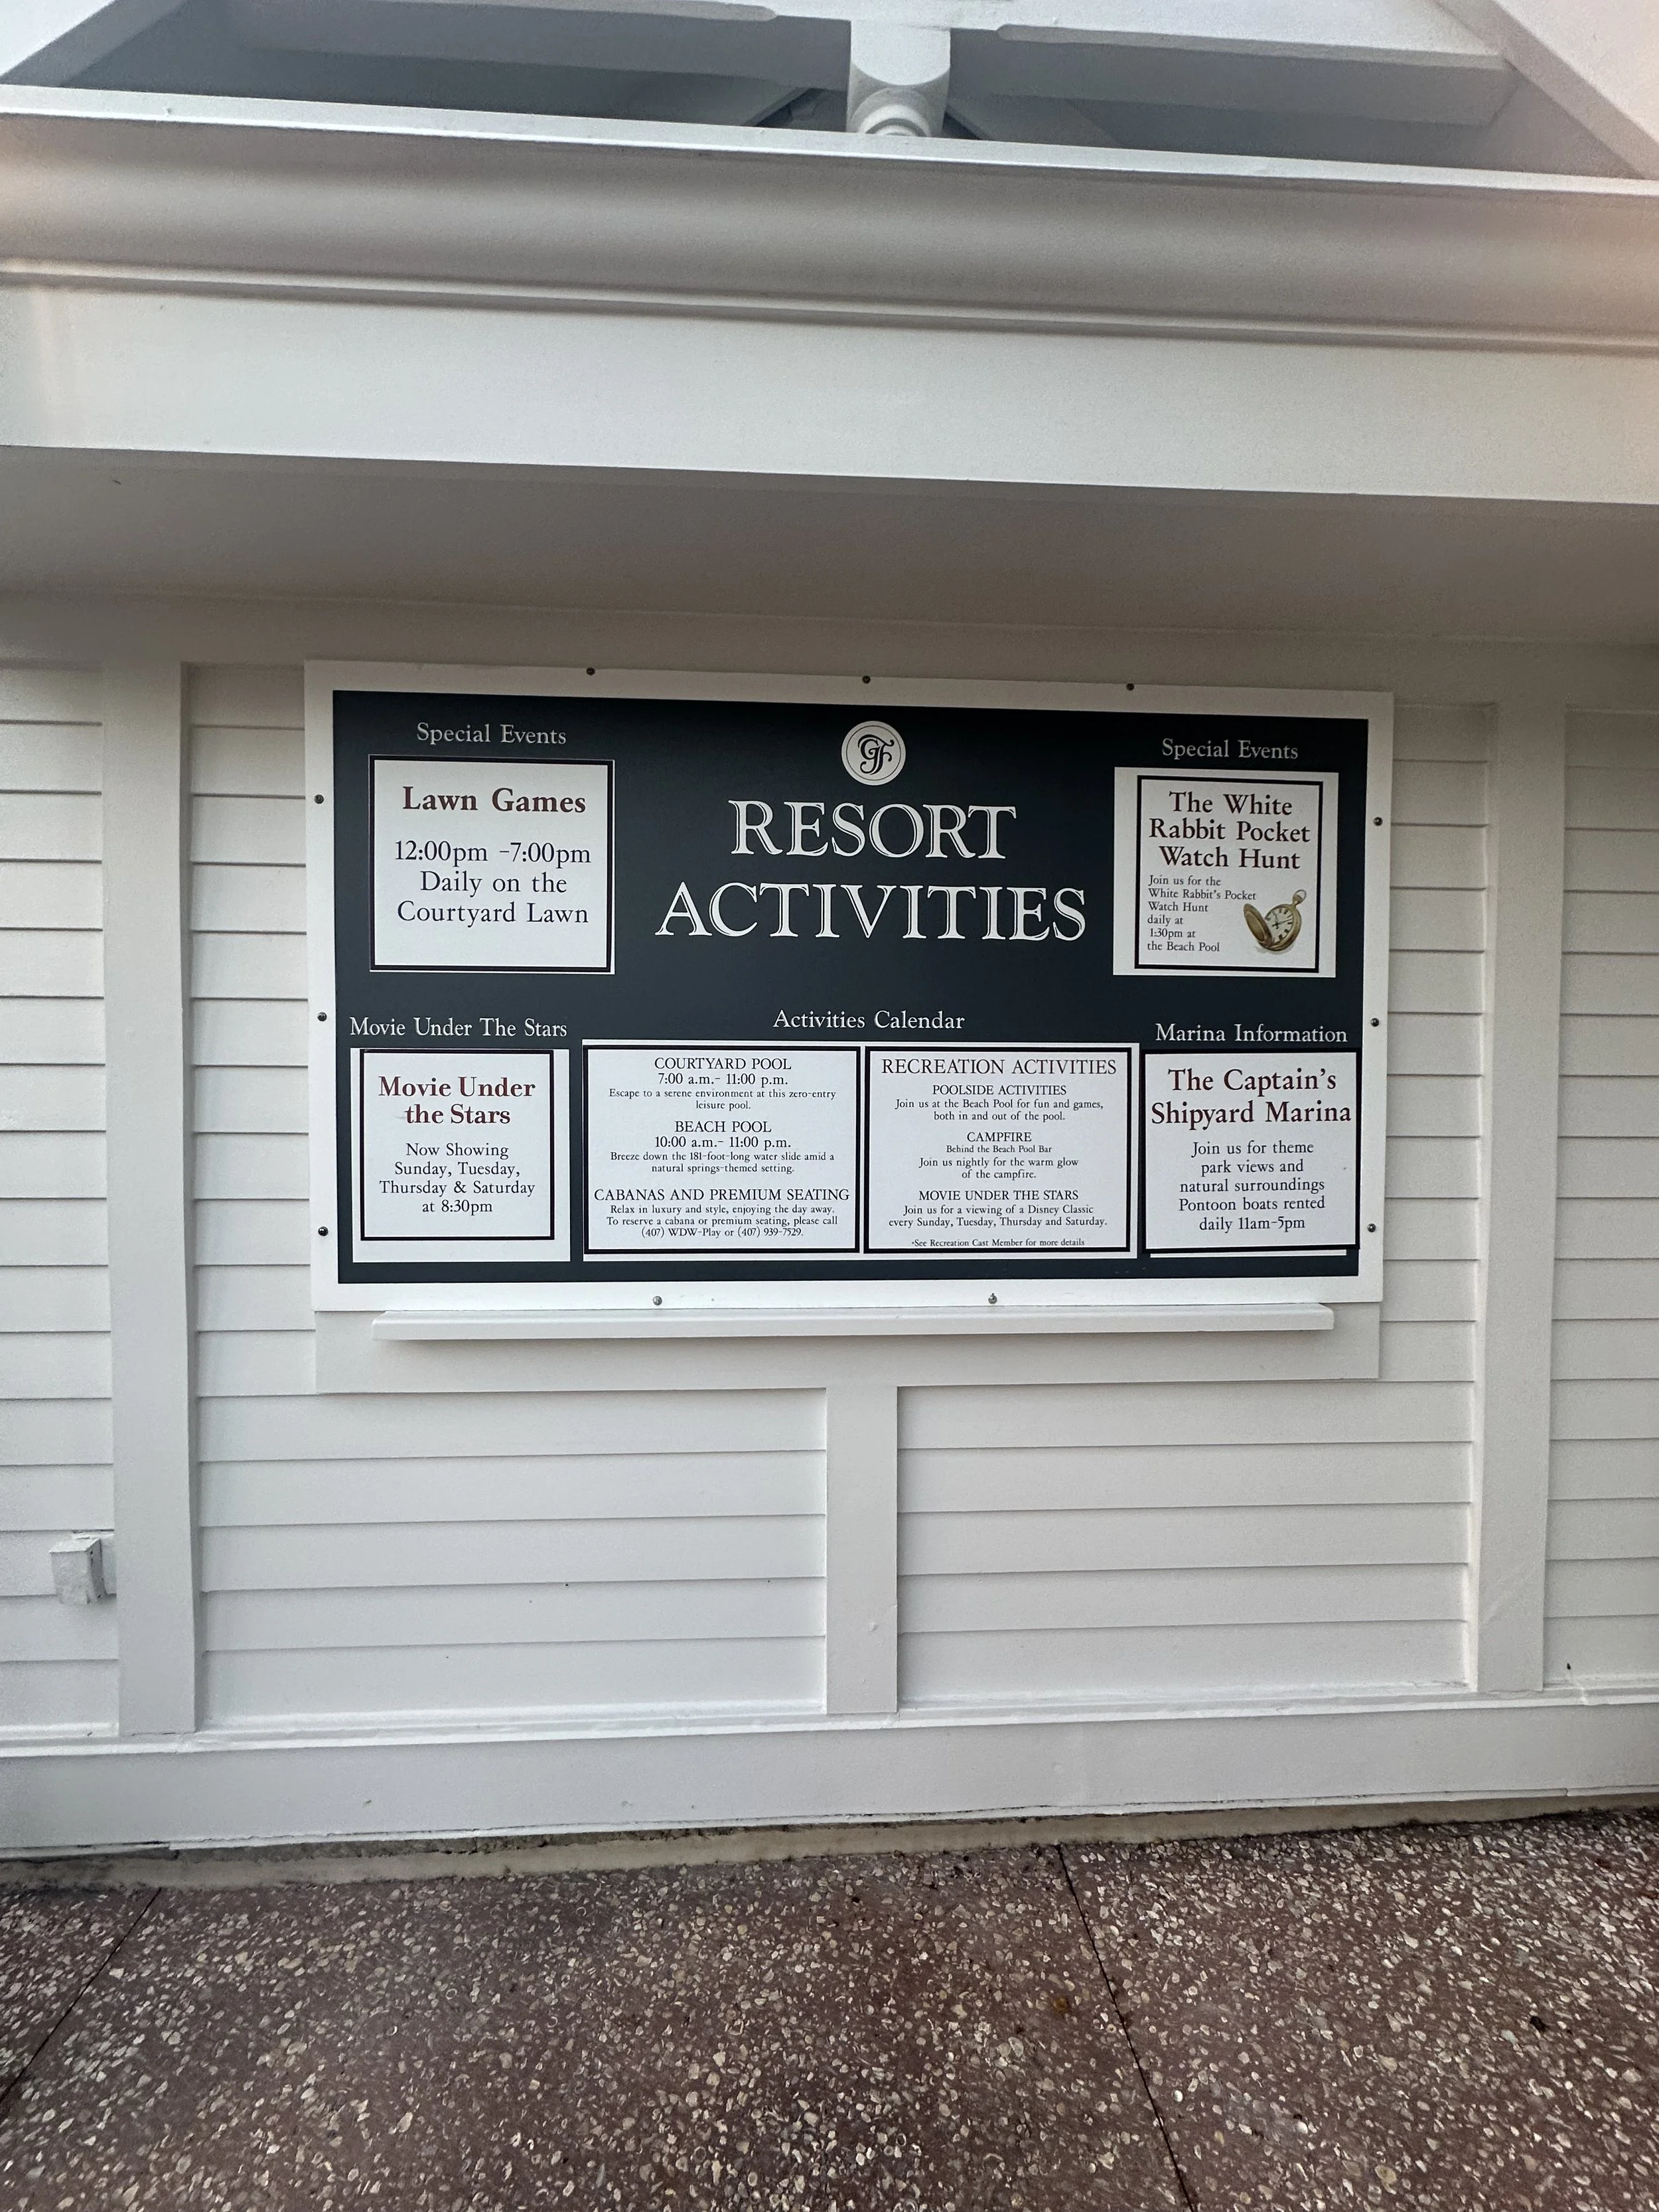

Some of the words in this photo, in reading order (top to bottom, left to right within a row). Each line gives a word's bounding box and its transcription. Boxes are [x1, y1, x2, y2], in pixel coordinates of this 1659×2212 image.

[417, 721, 491, 745] Special
[500, 724, 566, 745] Events
[1162, 738, 1230, 760] Special
[1238, 739, 1298, 759] Events
[402, 786, 478, 811] Lawn
[492, 787, 586, 813] Games
[1169, 790, 1213, 813] The
[1222, 793, 1293, 816] White
[728, 800, 1017, 859] RESORT
[1149, 817, 1226, 840] Rabbit
[1236, 820, 1311, 843] Pocket
[395, 840, 488, 867] 12:00pm
[1158, 846, 1230, 867] Watch
[1238, 848, 1301, 870] Hunt
[420, 870, 482, 897] Daily
[492, 878, 521, 892] on
[532, 871, 567, 893] the
[1147, 874, 1169, 887] Join
[1187, 875, 1202, 886] for
[1205, 875, 1222, 886] the
[1148, 887, 1179, 898] White
[1183, 889, 1221, 899] Rabbit's
[1224, 890, 1256, 901] Pocket
[397, 900, 516, 928] Courtyard
[526, 902, 589, 923] Lawn
[654, 881, 1086, 941] ACTIVITIES
[1147, 901, 1179, 911] Watch
[1183, 902, 1208, 913] Hunt
[1147, 914, 1171, 927] daily
[1150, 927, 1183, 940] 1:30pm
[1147, 940, 1163, 951] the
[1167, 940, 1195, 951] Beach
[1198, 942, 1220, 952] Pool
[349, 1017, 405, 1036] Movie
[413, 1017, 472, 1037] Under
[479, 1017, 516, 1037] The
[524, 1017, 567, 1037] Stars
[772, 1009, 865, 1028] Activities
[874, 1010, 966, 1029] Calendar
[1155, 1023, 1226, 1041] Marina
[1234, 1023, 1348, 1043] Information
[654, 1057, 747, 1070] COURTYARD
[751, 1057, 792, 1070] POOL
[881, 1059, 1005, 1074] RECREATION
[1011, 1059, 1117, 1074] ACTIVITIES
[378, 1076, 451, 1097] Movie
[457, 1076, 536, 1097] Under
[658, 1072, 684, 1084] 7:00
[726, 1072, 756, 1085] 11:00
[760, 1076, 788, 1088] p.m.
[1167, 1068, 1214, 1091] The
[1224, 1067, 1336, 1097] Captain's
[609, 1088, 640, 1100] Escape
[768, 1088, 786, 1098] this
[932, 1084, 994, 1095] POOLSIDE
[997, 1084, 1067, 1096] ACTIVITIES
[404, 1104, 444, 1124] the
[451, 1103, 511, 1124] Stars
[696, 1100, 725, 1109] leisure
[729, 1100, 751, 1112] pool.
[1151, 1100, 1255, 1131] Shipyard
[1265, 1100, 1352, 1122] Marina
[675, 1120, 726, 1133] BEACH
[732, 1120, 772, 1133] POOL
[655, 1136, 686, 1147] 10:00
[729, 1136, 758, 1147] 11:00
[764, 1140, 791, 1151] p.m.
[967, 1132, 1032, 1142] CAMPFIRE
[405, 1142, 440, 1156] Now
[446, 1142, 509, 1160] Showing
[610, 1151, 640, 1161] Breeze
[642, 1151, 668, 1161] down
[672, 1151, 686, 1161] the
[781, 1151, 801, 1161] slide
[804, 1151, 826, 1161] amid
[1190, 1141, 1220, 1158] Join
[1226, 1145, 1242, 1155] us
[1247, 1140, 1267, 1154] for
[1272, 1140, 1314, 1154] theme
[395, 1161, 452, 1179] Sunday,
[457, 1161, 520, 1179] Tuesday,
[918, 1157, 938, 1169] Join
[956, 1157, 989, 1169] nightly
[993, 1157, 1007, 1166] for
[1010, 1157, 1025, 1167] the
[1056, 1157, 1078, 1169] glow
[1200, 1159, 1232, 1177] park
[1236, 1159, 1275, 1173] views
[1279, 1158, 1304, 1173] and
[962, 1169, 973, 1179] of
[975, 1169, 991, 1179] the
[993, 1169, 1037, 1181] campfire.
[379, 1180, 447, 1198] Thursday
[453, 1181, 467, 1194] &
[473, 1179, 536, 1197] Saturday
[1180, 1178, 1228, 1193] natural
[1234, 1177, 1325, 1194] surroundings
[594, 1189, 665, 1201] CABANAS
[670, 1189, 704, 1201] AND
[709, 1189, 782, 1201] PREMIUM
[786, 1188, 850, 1201] SEATING
[919, 1190, 961, 1201] MOVIE
[965, 1190, 1009, 1201] UNDER
[1013, 1190, 1040, 1201] THE
[1043, 1189, 1079, 1201] STARS
[1179, 1198, 1236, 1211] Pontoon
[1242, 1197, 1278, 1211] boats
[1283, 1195, 1325, 1210] rented
[422, 1202, 435, 1213] at
[441, 1199, 493, 1217] 8:30pm
[902, 1205, 923, 1217] Join
[940, 1205, 954, 1214] for
[966, 1205, 1003, 1217] viewing
[1005, 1204, 1017, 1214] of
[1028, 1205, 1059, 1217] Disney
[1062, 1204, 1094, 1214] Classic
[889, 1220, 914, 1229] every
[916, 1217, 954, 1228] Sunday,
[956, 1217, 997, 1228] Tuesday,
[999, 1217, 1043, 1228] Thursday
[1045, 1217, 1062, 1226] and
[1065, 1216, 1108, 1228] Saturday.
[1199, 1216, 1233, 1234] daily
[641, 1227, 664, 1238] (407)
[668, 1227, 721, 1239] WDW-Play
[737, 1227, 760, 1238] (407)
[763, 1227, 804, 1236] 939-7529.
